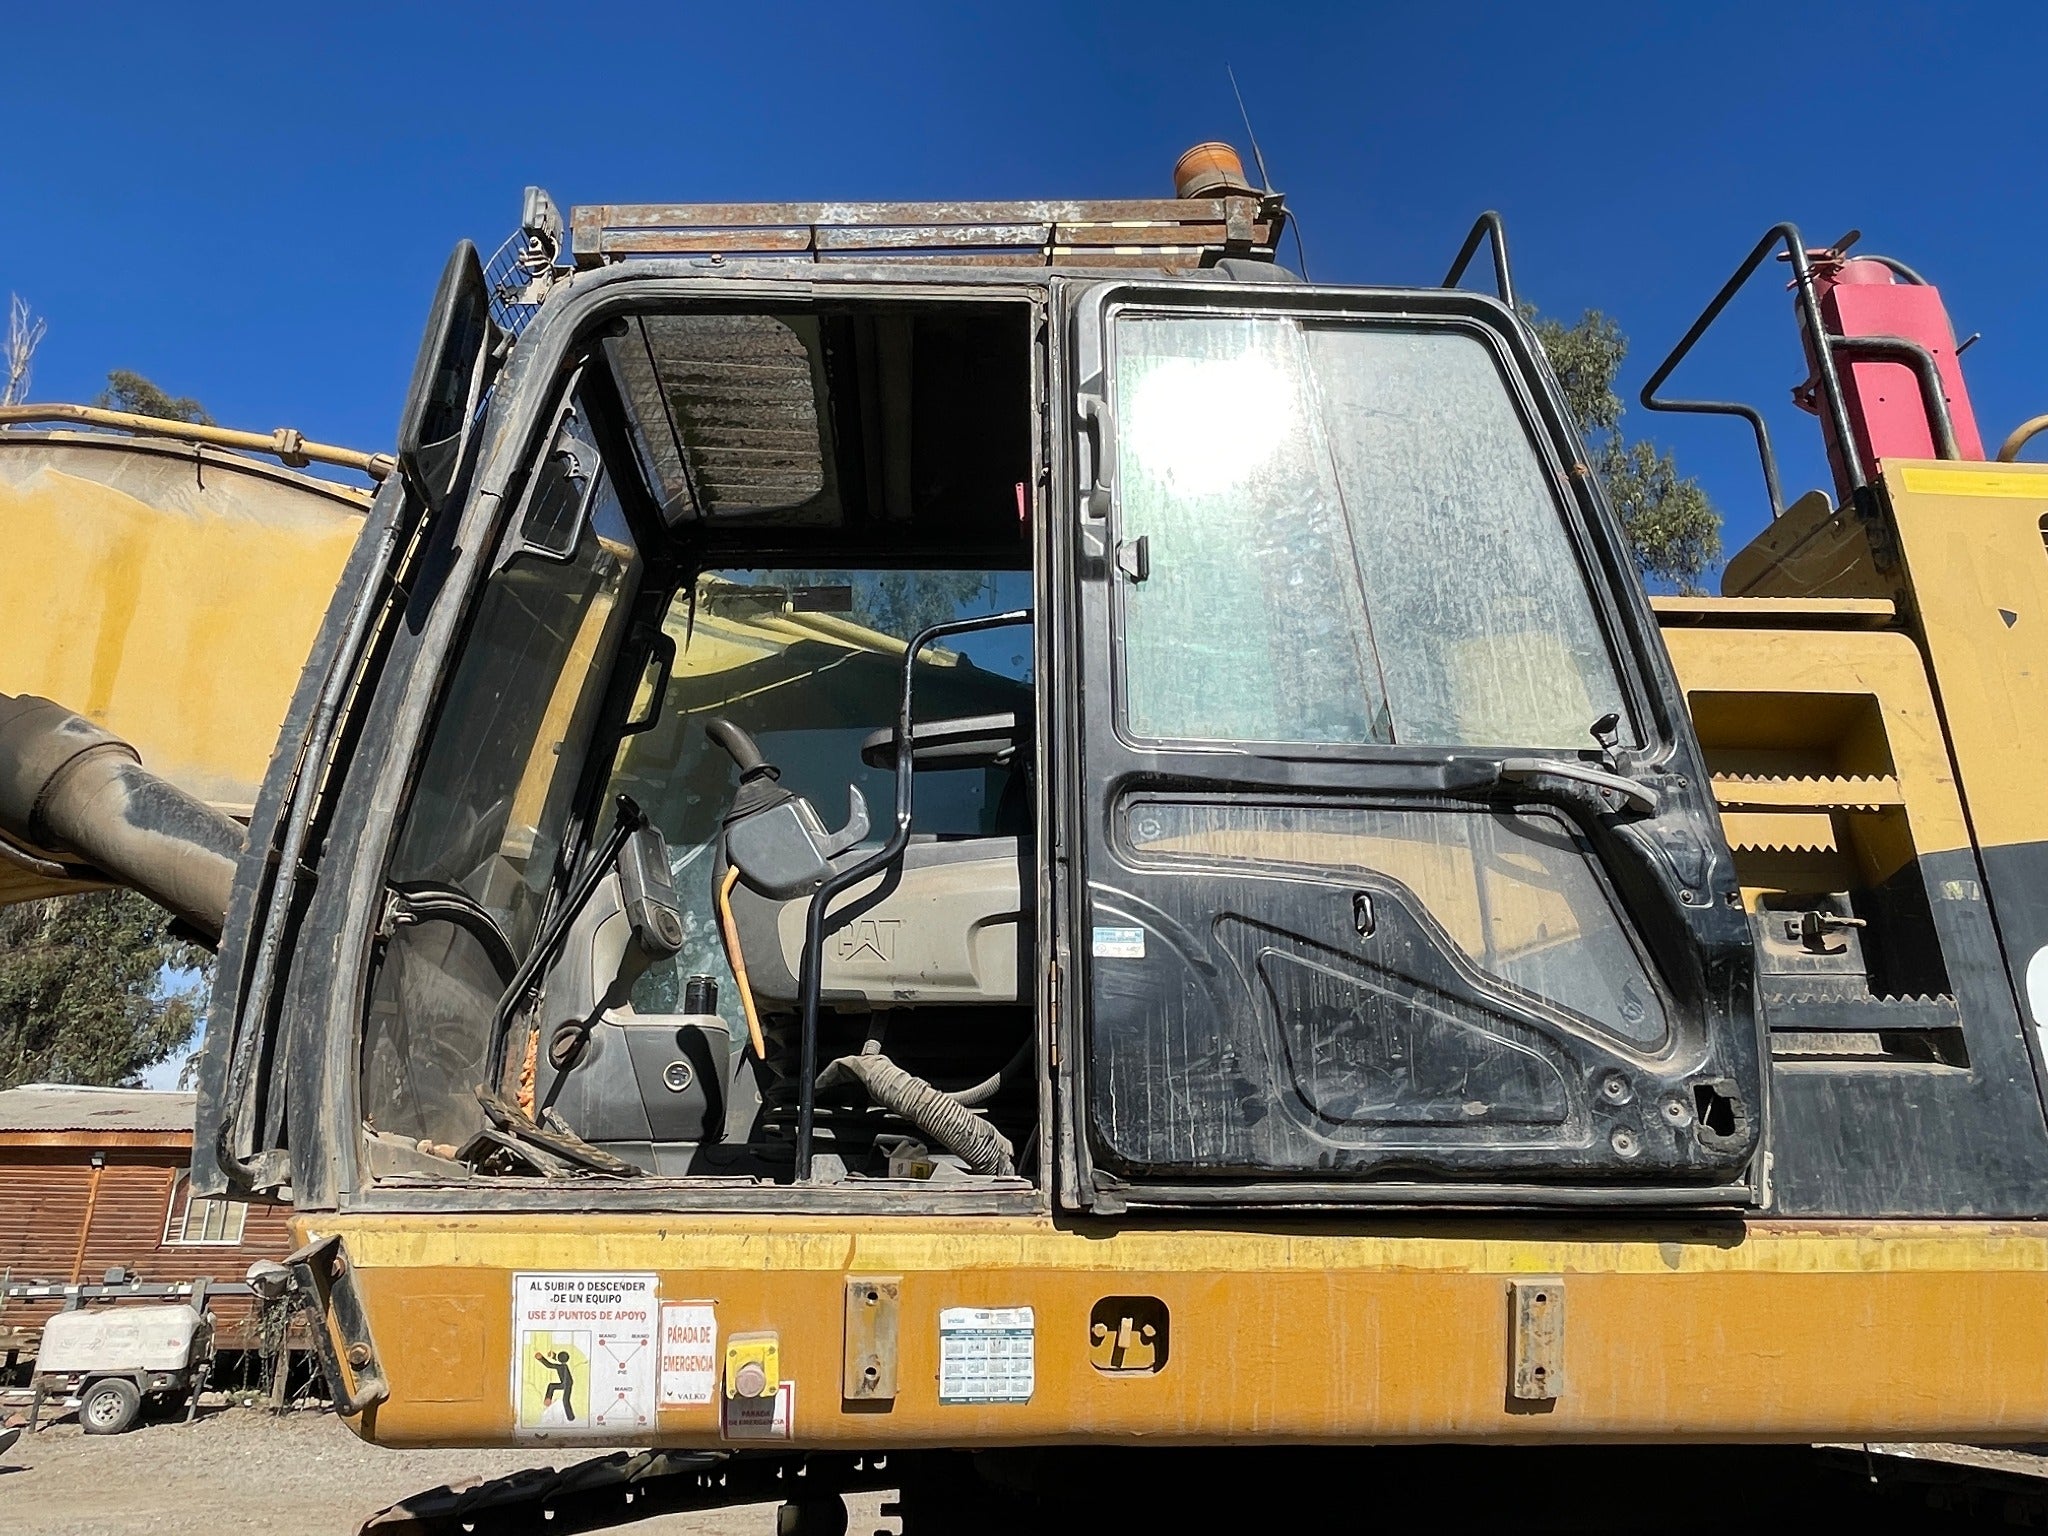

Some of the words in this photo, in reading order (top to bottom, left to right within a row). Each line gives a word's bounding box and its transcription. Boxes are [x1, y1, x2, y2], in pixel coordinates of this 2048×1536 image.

[837, 920, 901, 961] CAT
[530, 1282, 542, 1291] AL
[544, 1282, 574, 1291] SUBIR
[578, 1282, 585, 1291] O
[587, 1282, 646, 1292] DESCENDER
[553, 1294, 566, 1303] DE
[569, 1294, 583, 1303] UN
[586, 1294, 622, 1304] EQUIPO
[528, 1311, 546, 1320] USE
[549, 1311, 556, 1320] 3
[558, 1311, 597, 1320] PUNTOS
[600, 1311, 611, 1320] DE
[614, 1311, 647, 1321] APOYO
[700, 1326, 711, 1343] DE
[663, 1355, 713, 1372] EMERGENCIA
